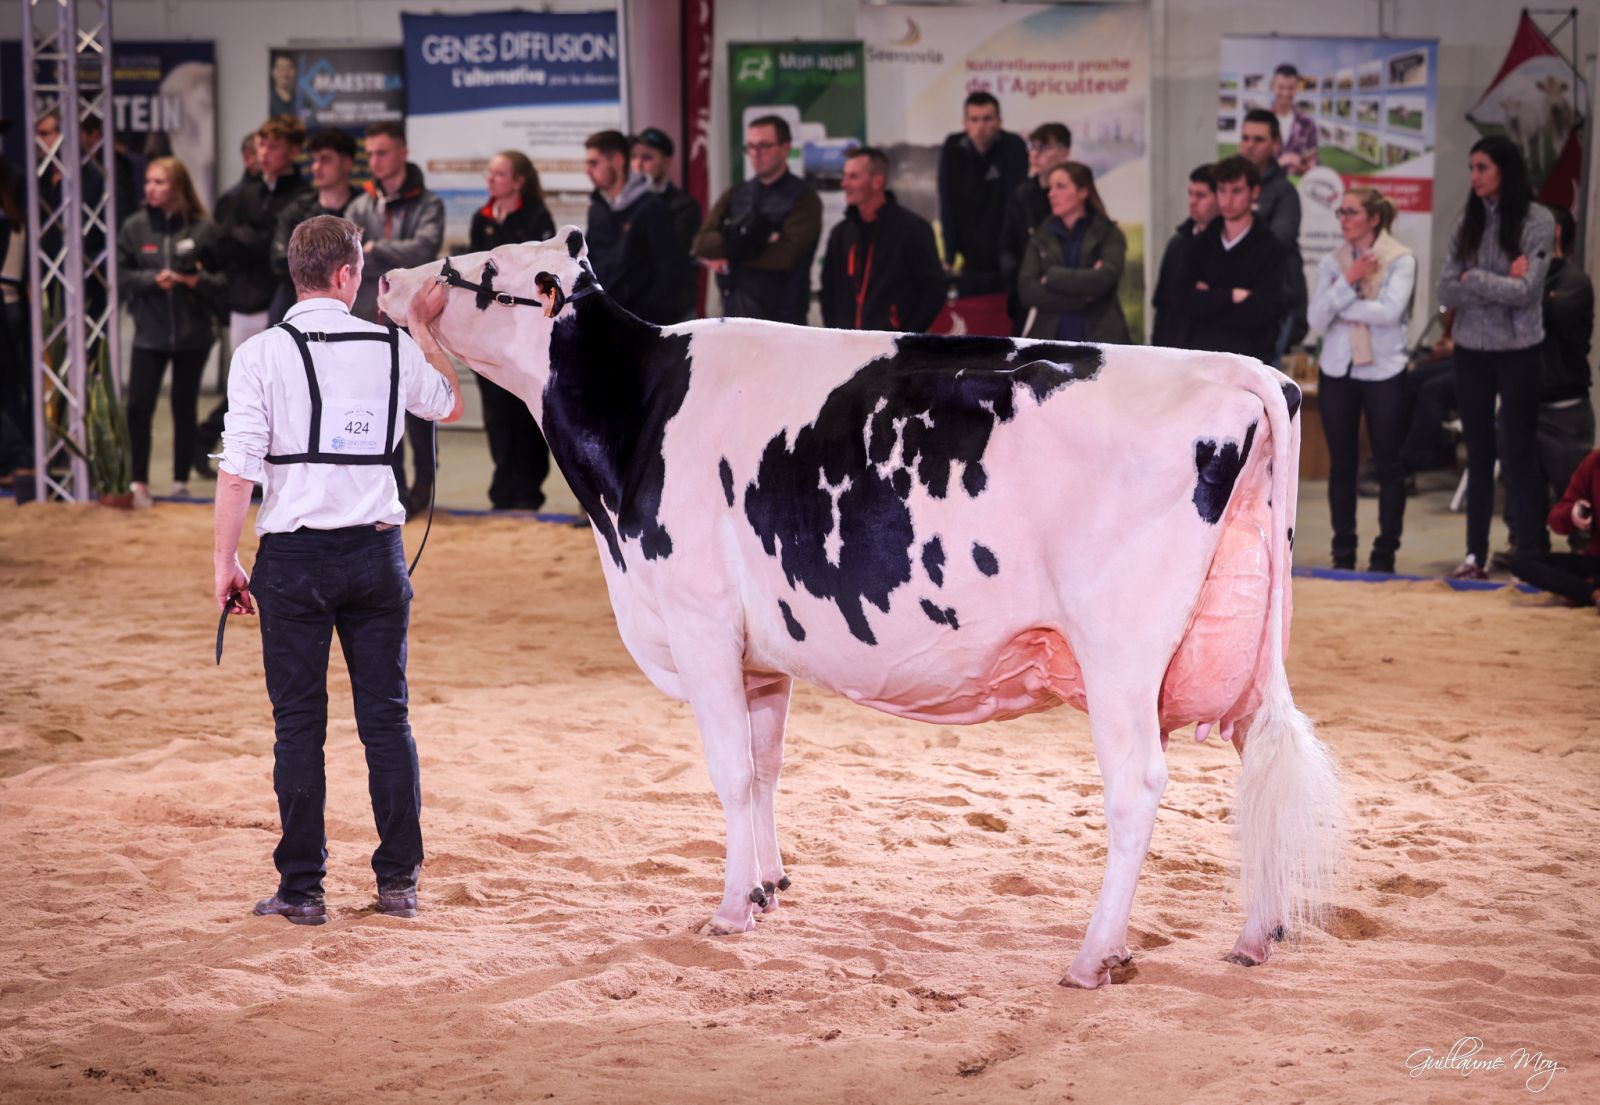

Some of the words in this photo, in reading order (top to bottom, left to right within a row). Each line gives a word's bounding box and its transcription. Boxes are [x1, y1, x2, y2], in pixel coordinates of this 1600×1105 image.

[421, 33, 498, 65] GENES
[501, 31, 616, 63] DIFFUSION
[779, 51, 813, 69] Mon
[964, 57, 1075, 73] Naturellement
[1077, 57, 1132, 76] proche
[965, 77, 991, 94] de
[997, 77, 1131, 98] l'Agriculteur
[344, 421, 369, 435] 424
